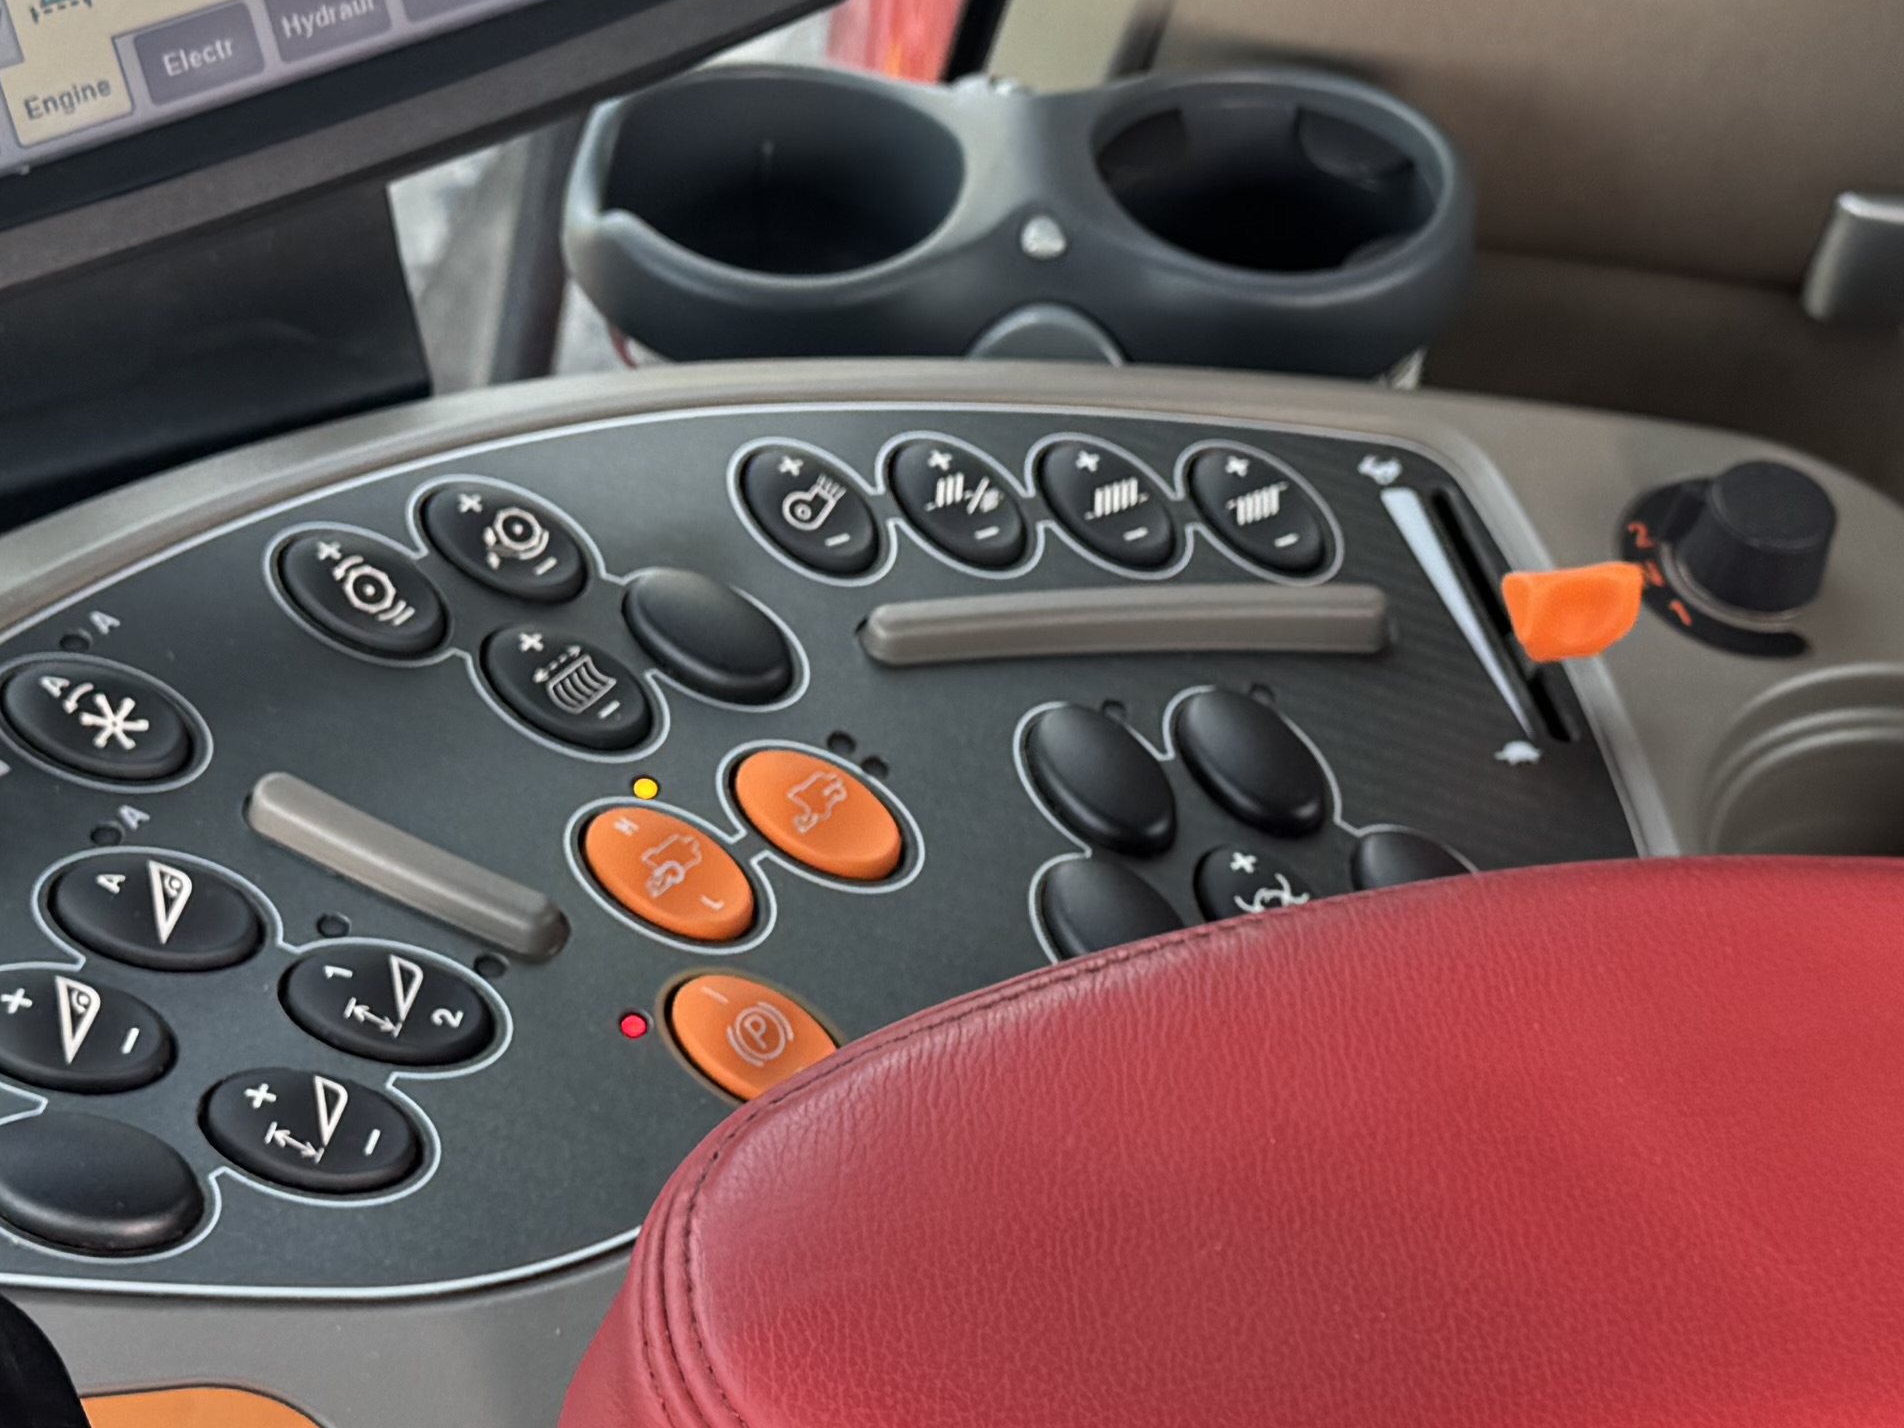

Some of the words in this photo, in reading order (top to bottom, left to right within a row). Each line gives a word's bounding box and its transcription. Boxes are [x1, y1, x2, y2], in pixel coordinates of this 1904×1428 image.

[162, 37, 234, 78] Electr
[23, 75, 112, 121] Engine
[90, 611, 120, 635] A
[40, 675, 72, 698] A
[118, 805, 151, 830] A
[96, 873, 126, 894] A
